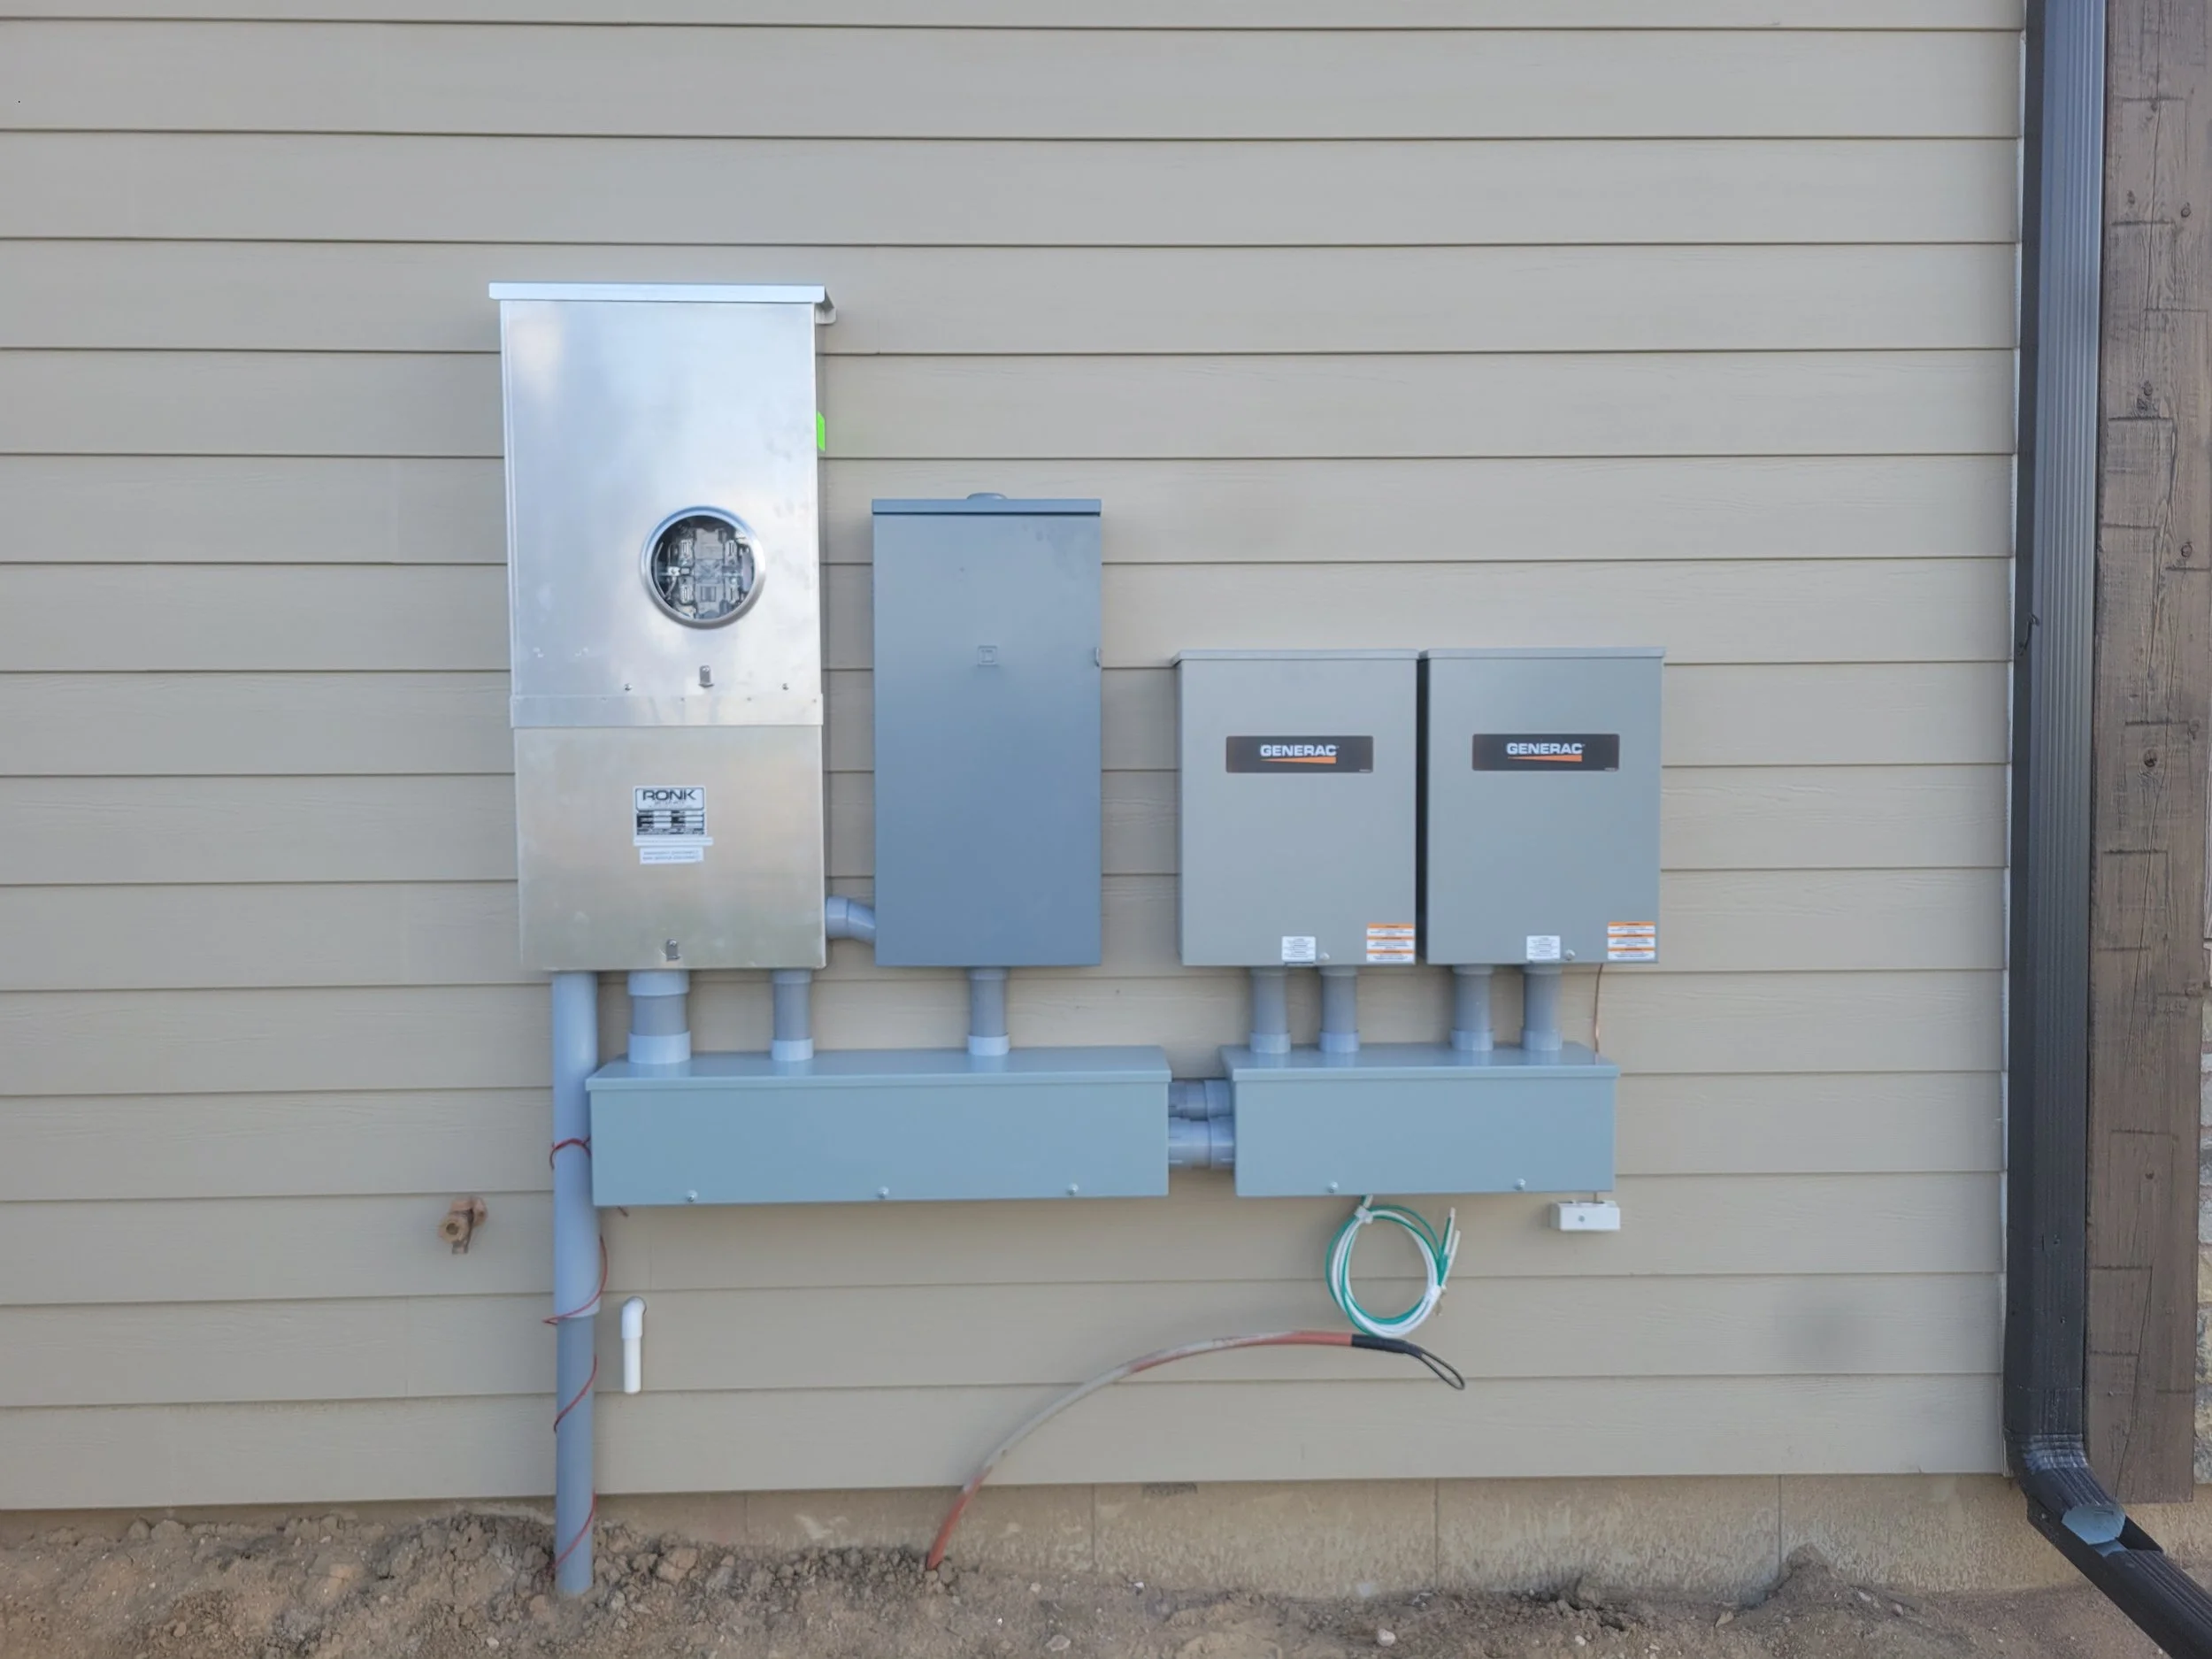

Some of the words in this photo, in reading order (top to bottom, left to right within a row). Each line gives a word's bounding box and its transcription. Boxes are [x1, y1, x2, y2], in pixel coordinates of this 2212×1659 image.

[1260, 744, 1337, 757] GENERAC
[1506, 742, 1583, 755] GENERAC
[642, 788, 696, 801] RONK
